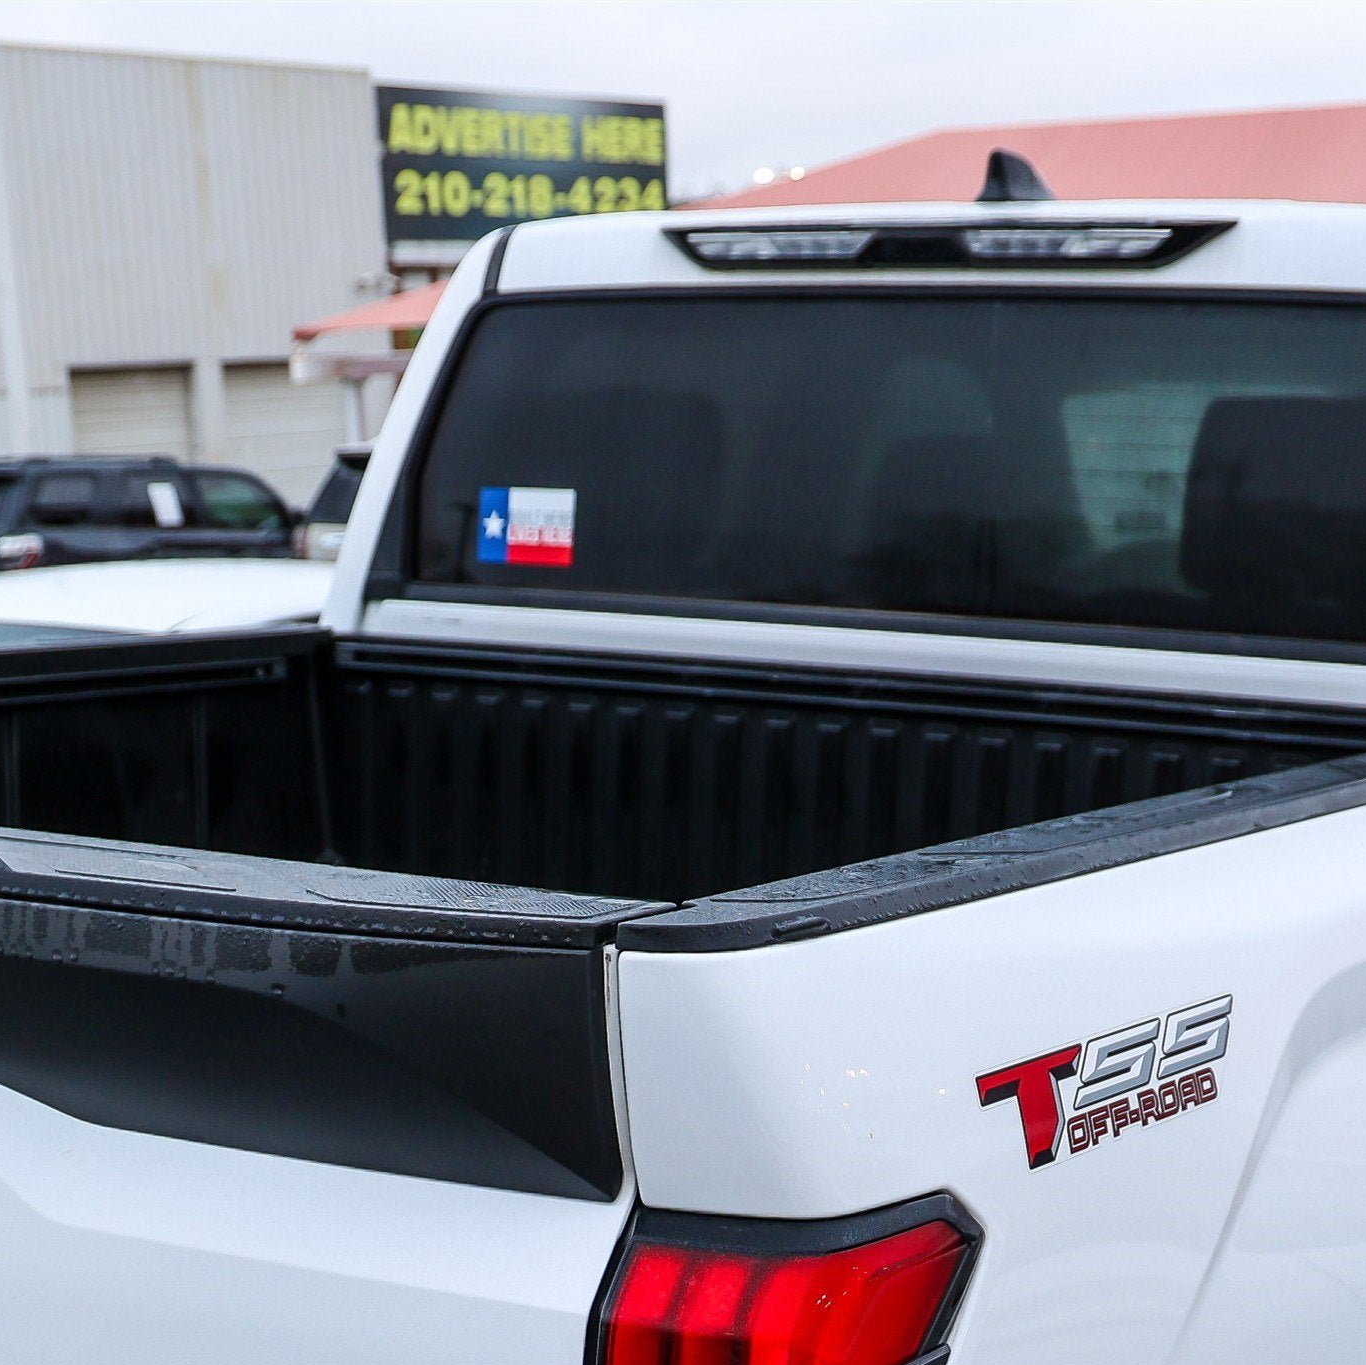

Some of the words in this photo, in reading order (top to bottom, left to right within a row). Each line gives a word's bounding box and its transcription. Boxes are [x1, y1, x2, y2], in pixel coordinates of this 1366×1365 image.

[388, 102, 573, 161] ADVERTISE
[581, 114, 665, 166] HERE
[975, 993, 1233, 1170] TSS
[1067, 1066, 1218, 1155] OFF-ROAD
